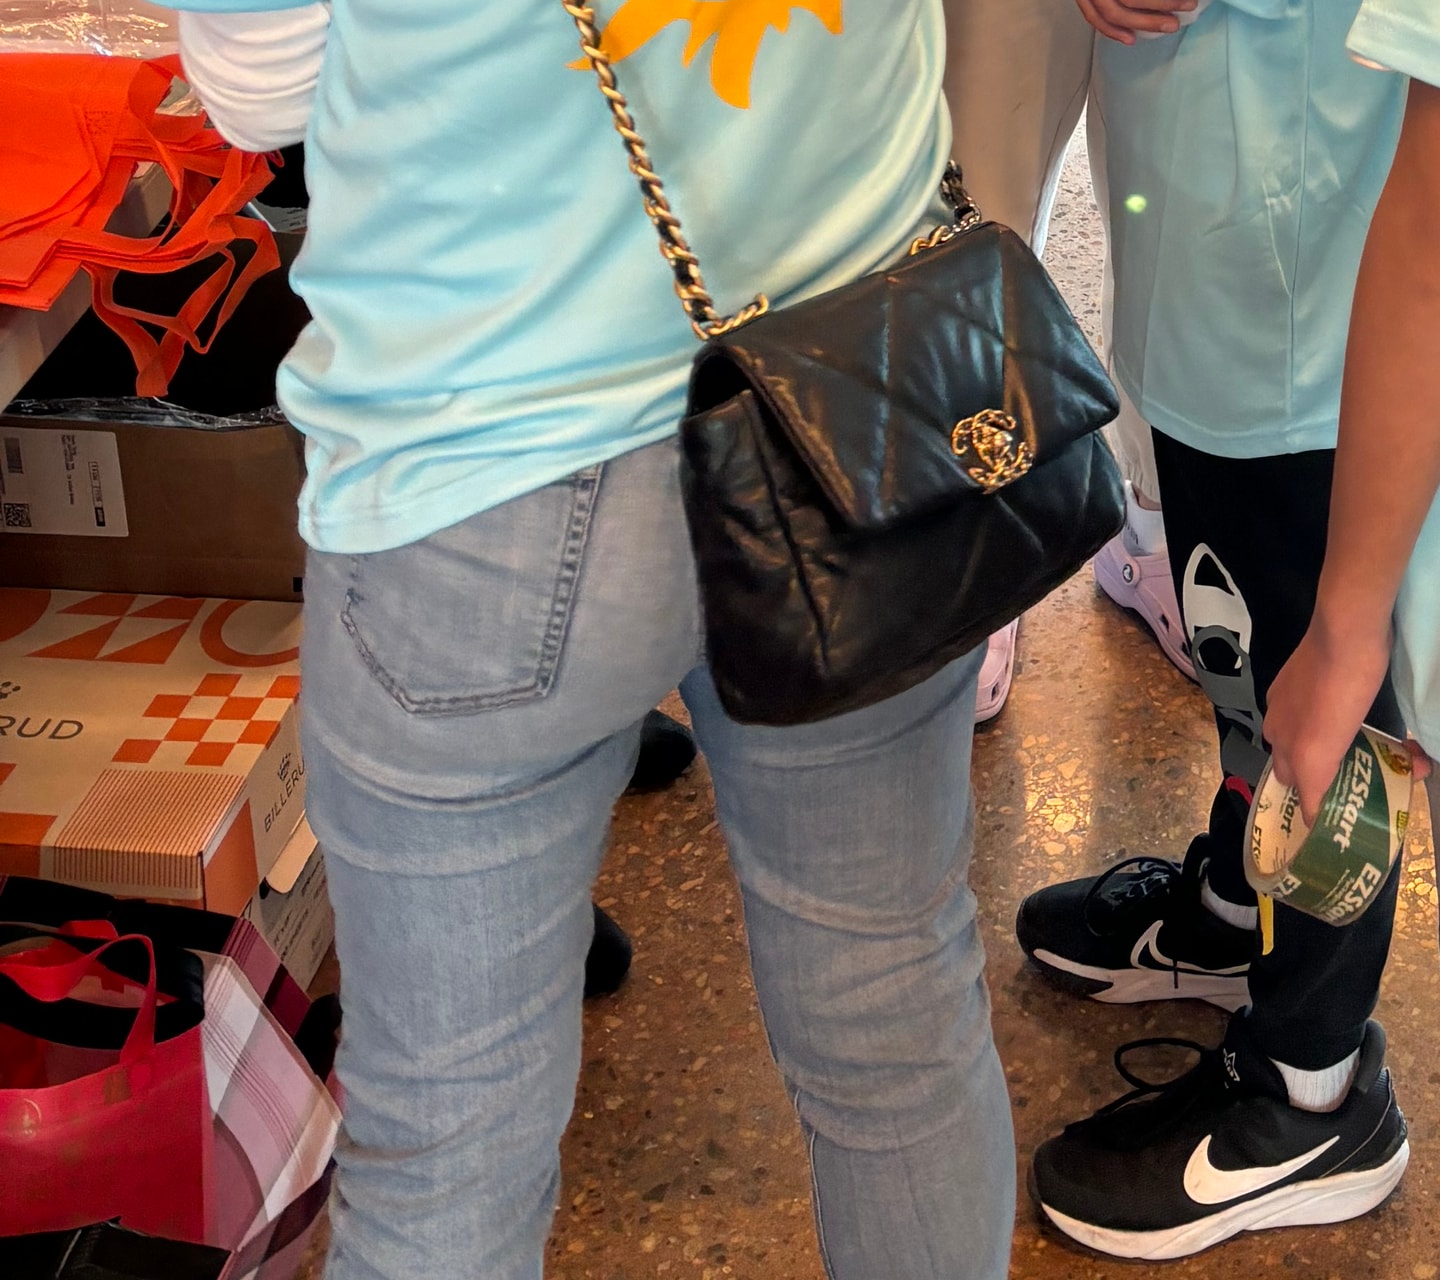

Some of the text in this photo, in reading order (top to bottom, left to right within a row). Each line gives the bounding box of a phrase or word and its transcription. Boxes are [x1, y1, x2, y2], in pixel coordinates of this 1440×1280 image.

[264, 759, 306, 832] BILLERU
[1333, 747, 1373, 853] EZStart
[1324, 862, 1382, 921] EZStar
